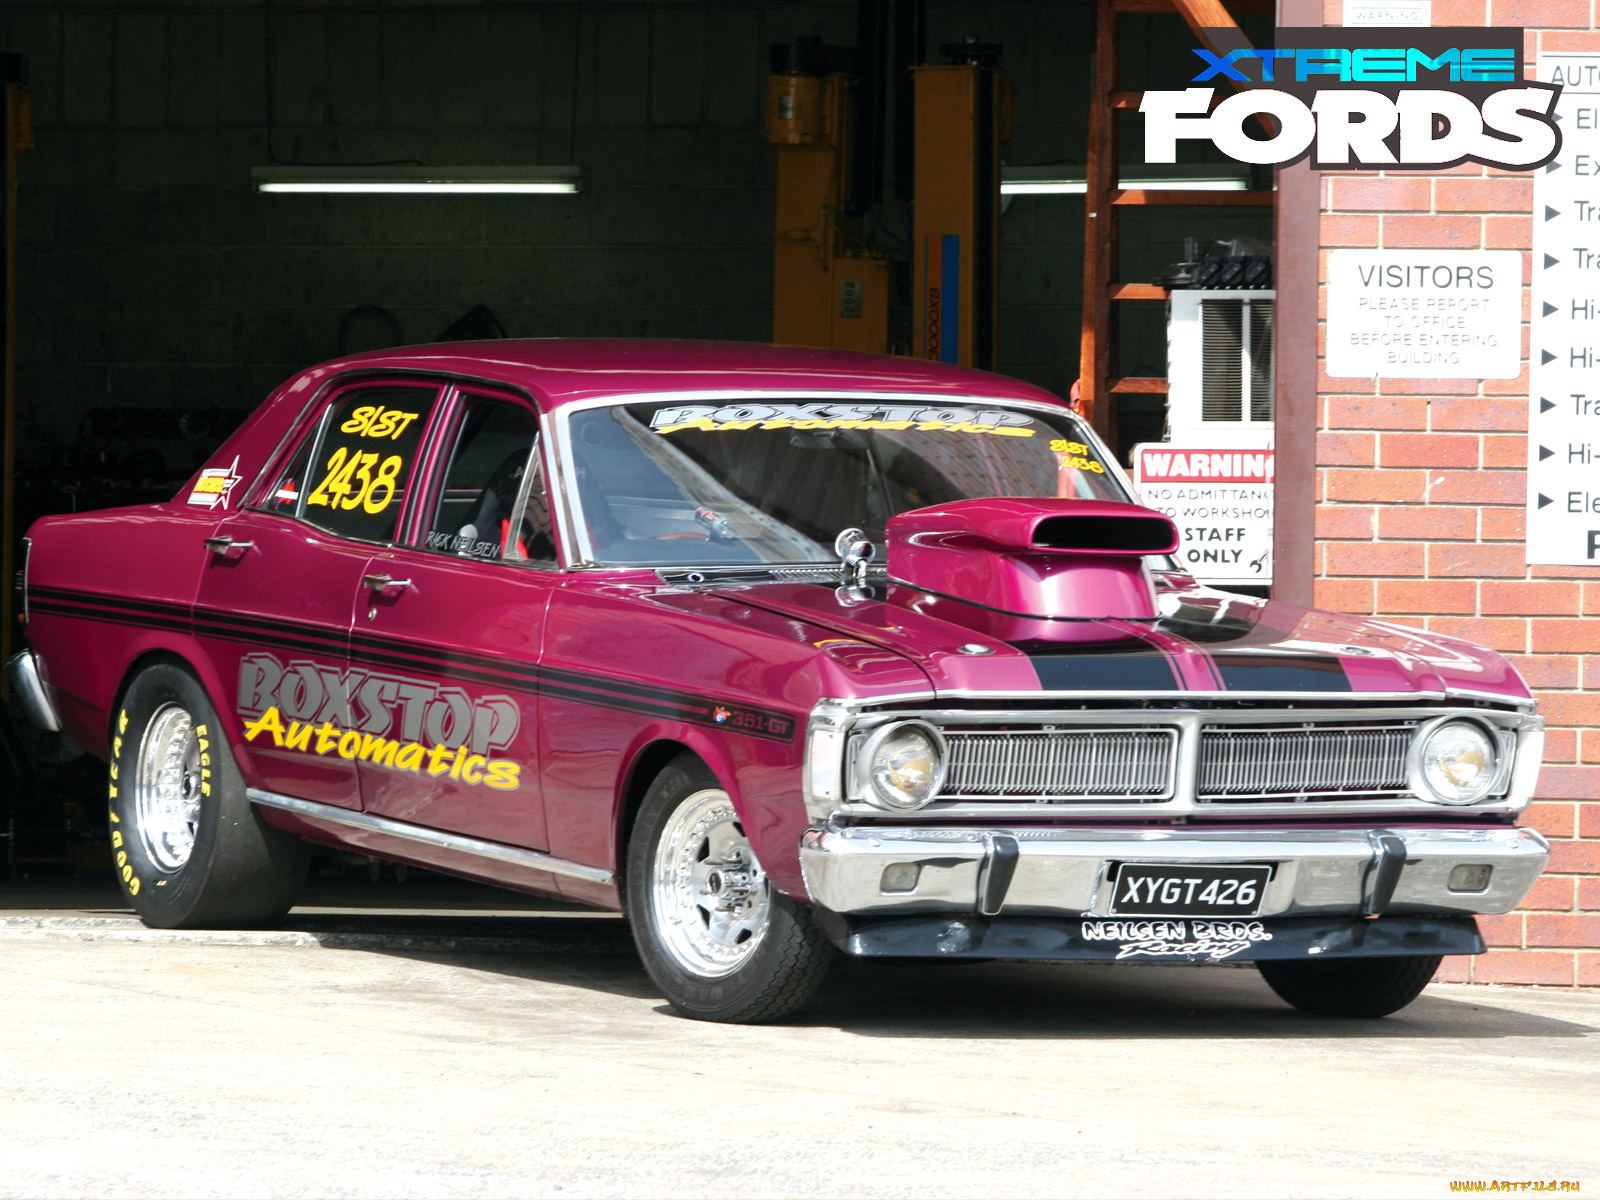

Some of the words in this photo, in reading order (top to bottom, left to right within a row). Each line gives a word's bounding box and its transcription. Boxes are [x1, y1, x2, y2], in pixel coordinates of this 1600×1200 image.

[1551, 65, 1600, 86] AUT
[1574, 200, 1600, 221] Tr
[1358, 265, 1494, 289] VISITORS
[1359, 297, 1420, 310] PLEASE
[1426, 298, 1491, 311] REPORT
[1384, 315, 1404, 328] TO
[1411, 315, 1467, 329] OFFICE
[1350, 333, 1412, 346] BEFORE
[1419, 333, 1498, 347] ENTERING
[1387, 351, 1461, 364] BUILDING
[650, 403, 1034, 429] BOXSTOP
[308, 447, 402, 514] 2438
[1148, 489, 1172, 500] NO
[1184, 527, 1246, 542] STAFF
[1187, 549, 1243, 563] ONLY
[237, 652, 521, 760] BOXSTOP
[243, 705, 521, 791] Automatics
[196, 724, 212, 797] EAGLE
[1121, 877, 1257, 905] XYGT426
[1081, 921, 1186, 941] NEILSEN
